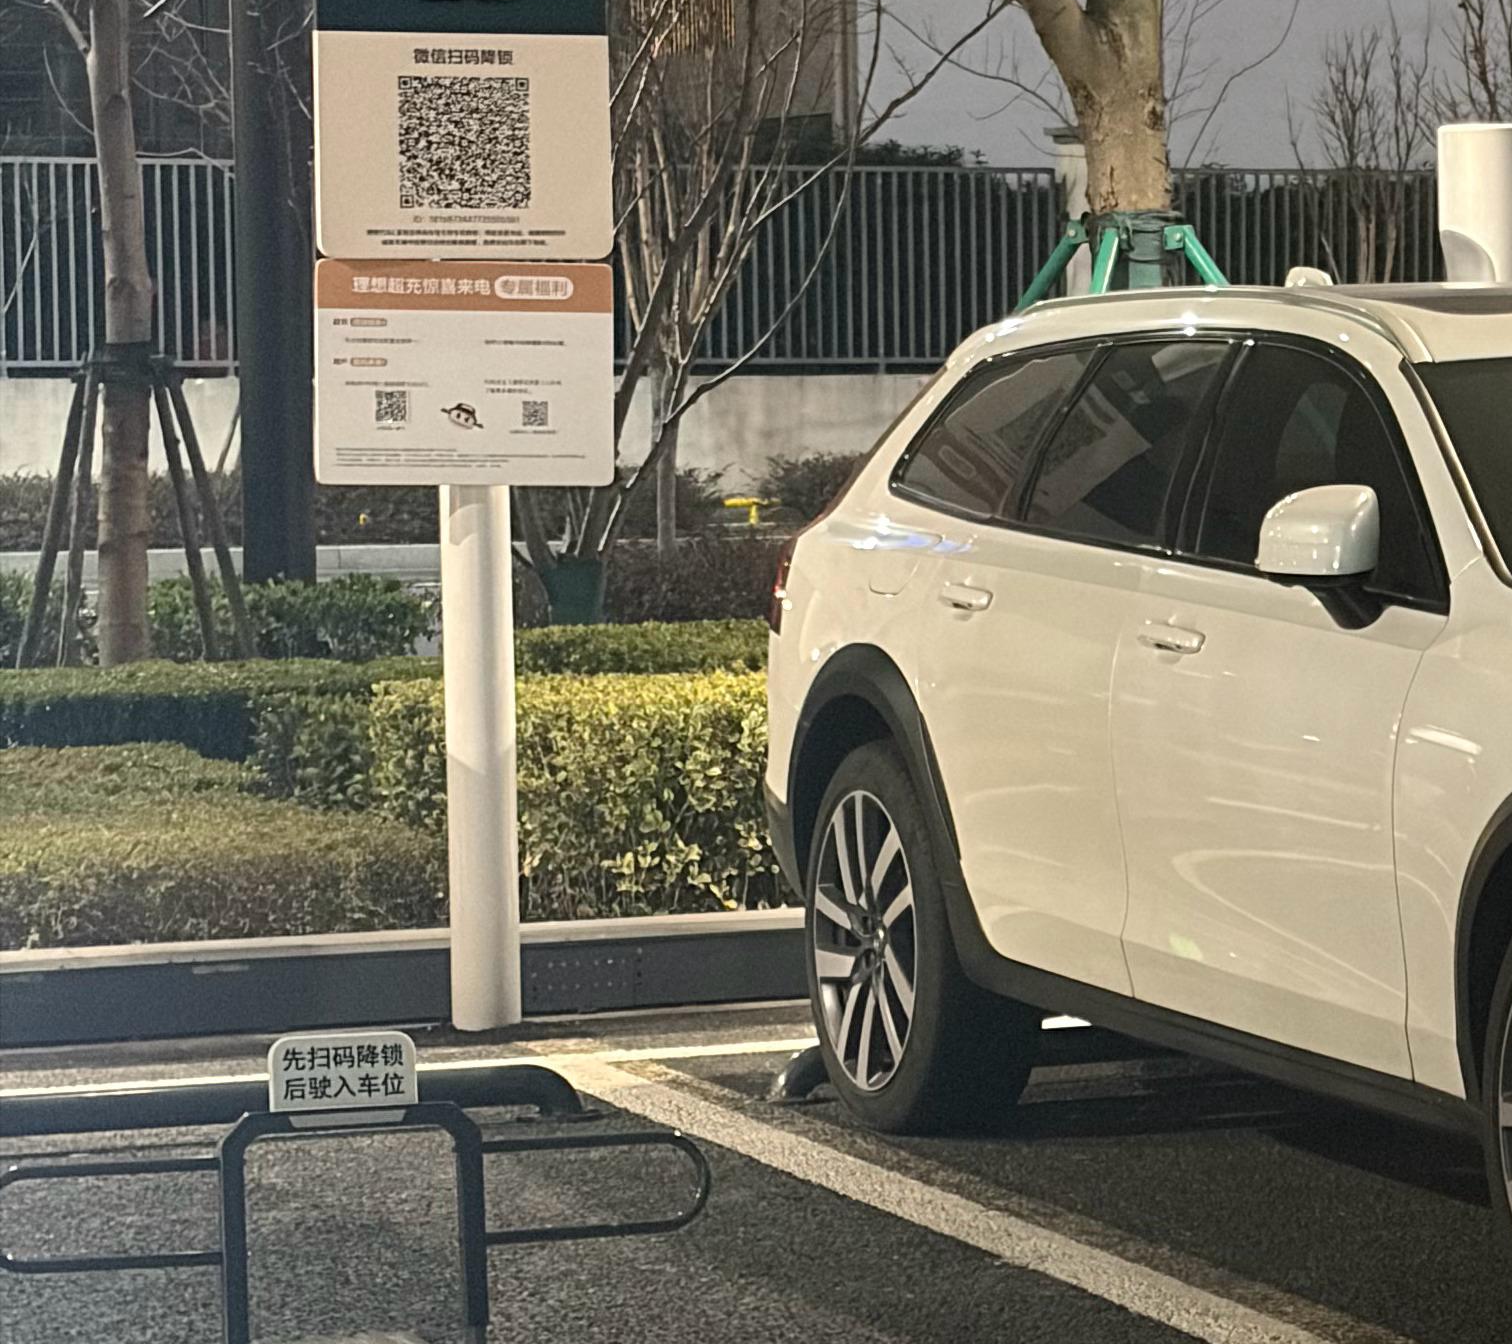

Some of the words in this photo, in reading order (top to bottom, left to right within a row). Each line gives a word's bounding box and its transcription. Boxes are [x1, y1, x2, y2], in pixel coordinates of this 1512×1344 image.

[413, 48, 513, 65] 微信扫码降锁
[352, 276, 491, 296] 理想超充惊喜来电
[500, 278, 568, 297] 专属福利
[282, 1043, 404, 1072] 先扫码降锁
[282, 1072, 406, 1102] 后驶入车位
